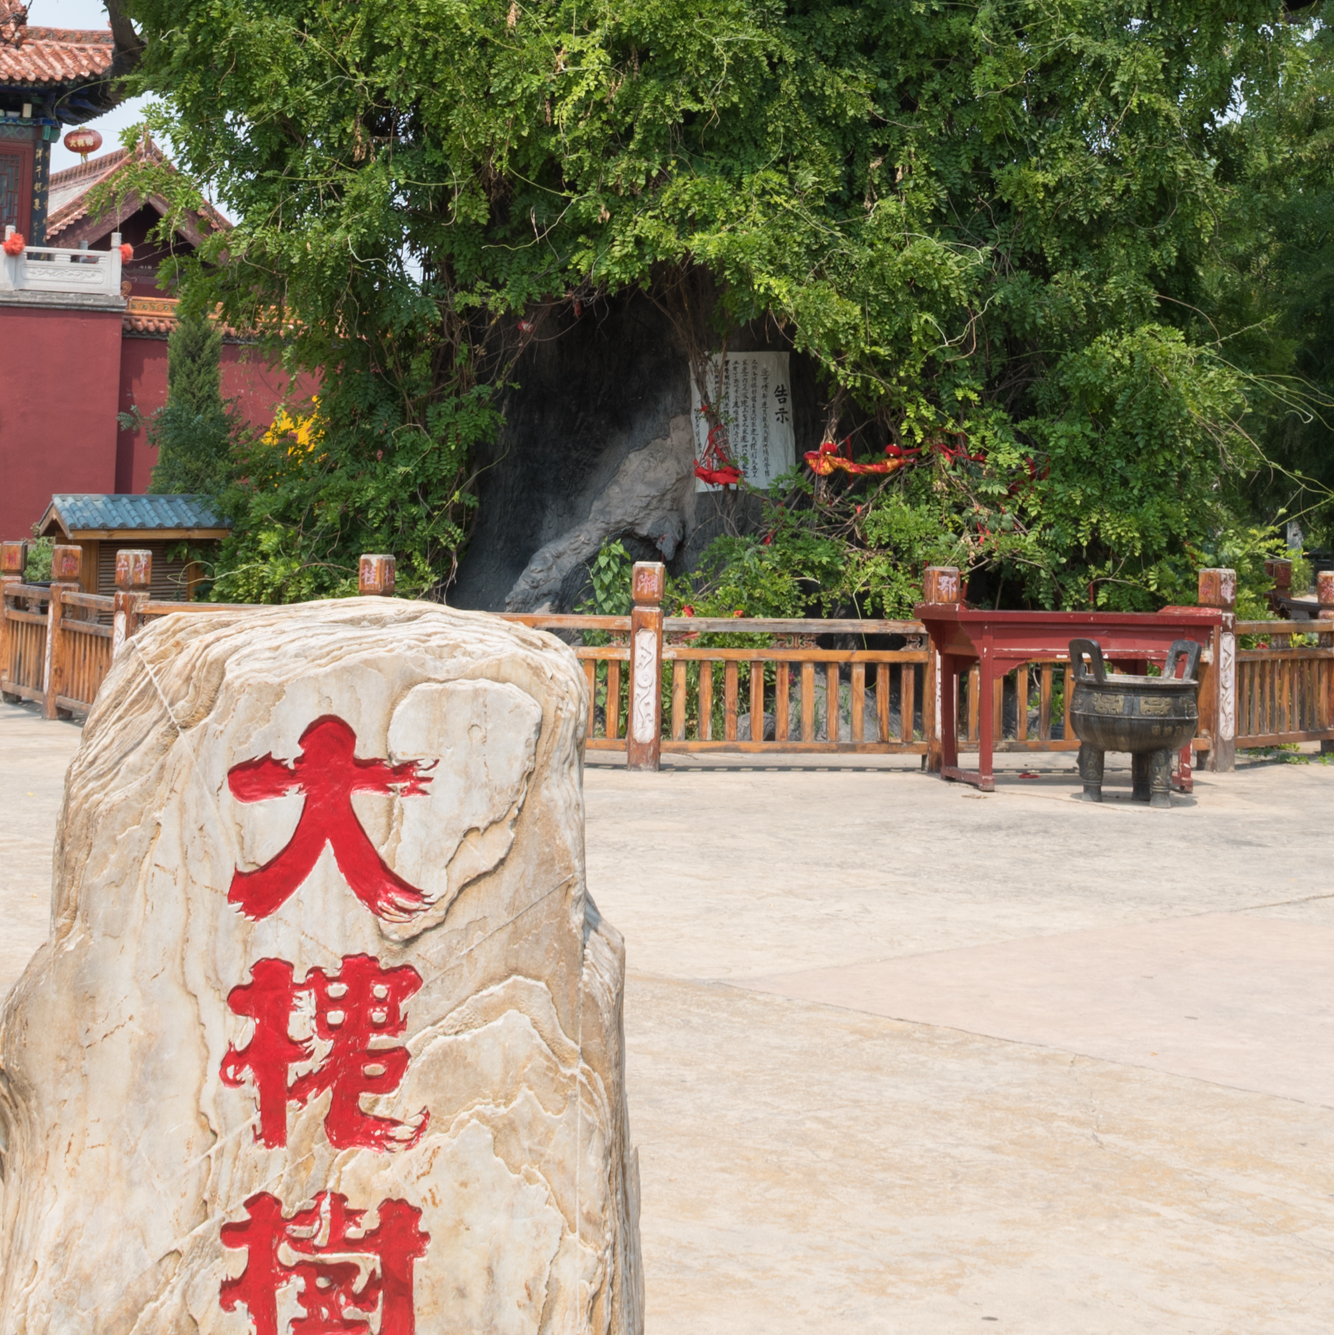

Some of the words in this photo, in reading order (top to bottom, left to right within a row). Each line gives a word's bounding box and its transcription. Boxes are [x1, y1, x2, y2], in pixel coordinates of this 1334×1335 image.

[773, 383, 789, 424] 告示
[362, 564, 378, 586] 桂
[637, 571, 658, 594] 湘
[937, 575, 957, 600] 鄂
